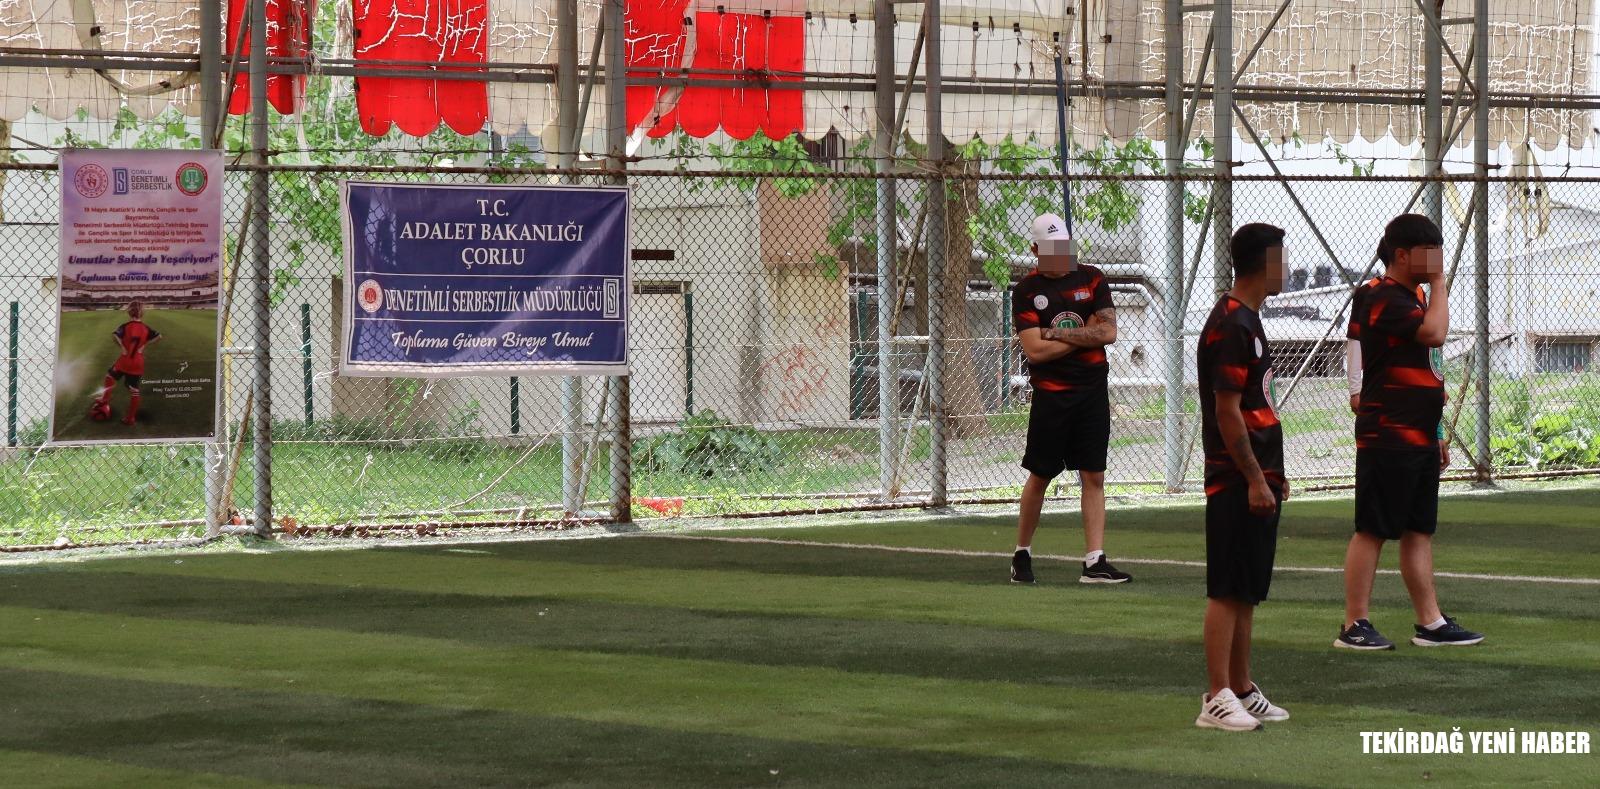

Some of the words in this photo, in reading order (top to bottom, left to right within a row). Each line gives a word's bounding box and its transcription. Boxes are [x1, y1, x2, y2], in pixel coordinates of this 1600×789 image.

[476, 200, 510, 217] T.C.
[400, 222, 476, 240] ADALET
[480, 220, 584, 242] BAKANLIĞI
[68, 256, 115, 265] Umutlar
[117, 255, 158, 264] Sahada
[462, 248, 526, 270] ÇORLU
[76, 271, 116, 282] Topluma
[152, 272, 181, 282] Bireye
[384, 285, 450, 312] DENETİMLİ
[452, 286, 520, 312] SERBESTLİK
[523, 286, 602, 312] MÜDÜRLÜĞÜ
[392, 330, 448, 355] Topluma
[452, 332, 497, 349] Güven
[502, 332, 546, 355] Bireye
[552, 332, 594, 348] Umut
